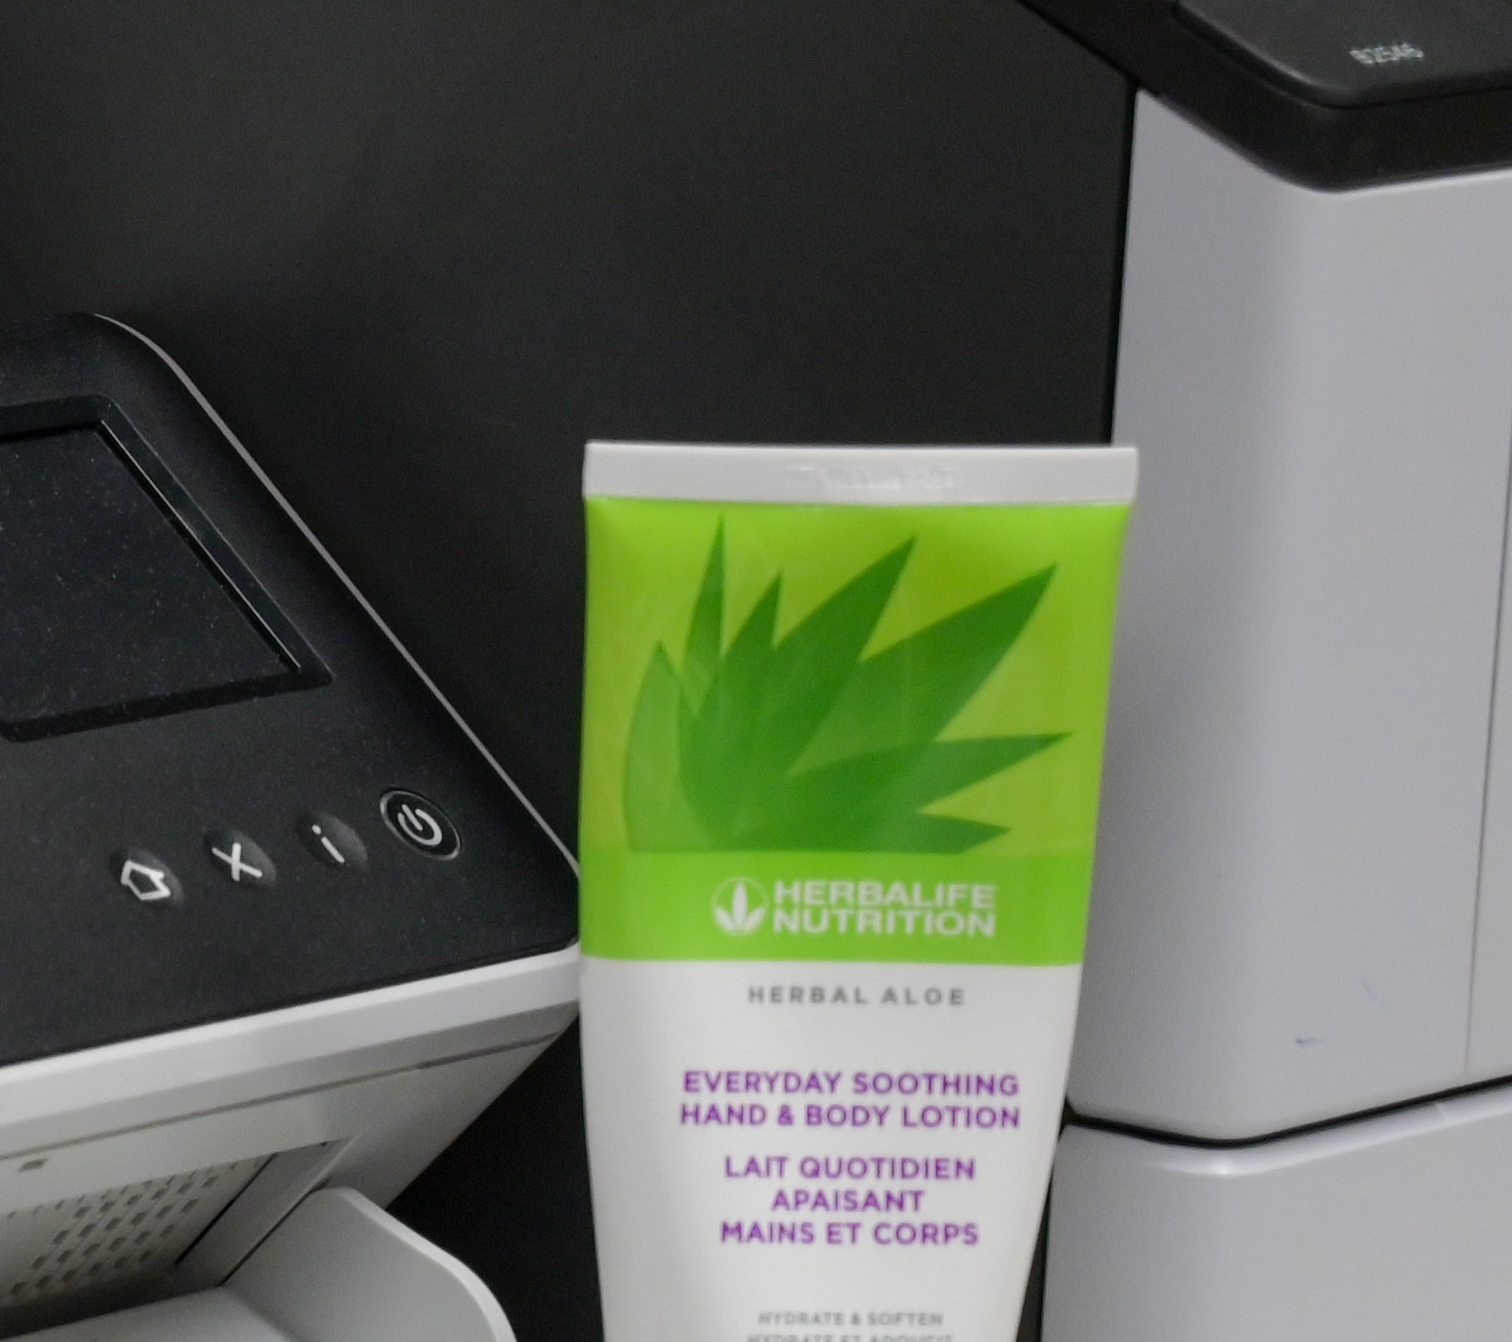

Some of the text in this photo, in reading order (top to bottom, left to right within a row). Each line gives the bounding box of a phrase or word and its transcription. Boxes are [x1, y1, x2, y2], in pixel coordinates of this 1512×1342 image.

[774, 880, 996, 909] HERBALIFE
[772, 909, 996, 937] NUTRITION
[748, 986, 965, 1006] HERBAL ALOE
[683, 1071, 1020, 1096] EVERYDAY SOOTHING
[680, 1104, 1020, 1129] HAND & BODY LOTION
[725, 1157, 976, 1182] LAIT QUOTIDIEN
[771, 1189, 924, 1212] APAISANT
[720, 1222, 979, 1246] MAINS ET CORPS
[758, 1311, 844, 1326] HYDRATE
[868, 1312, 943, 1326] SOFTEN
